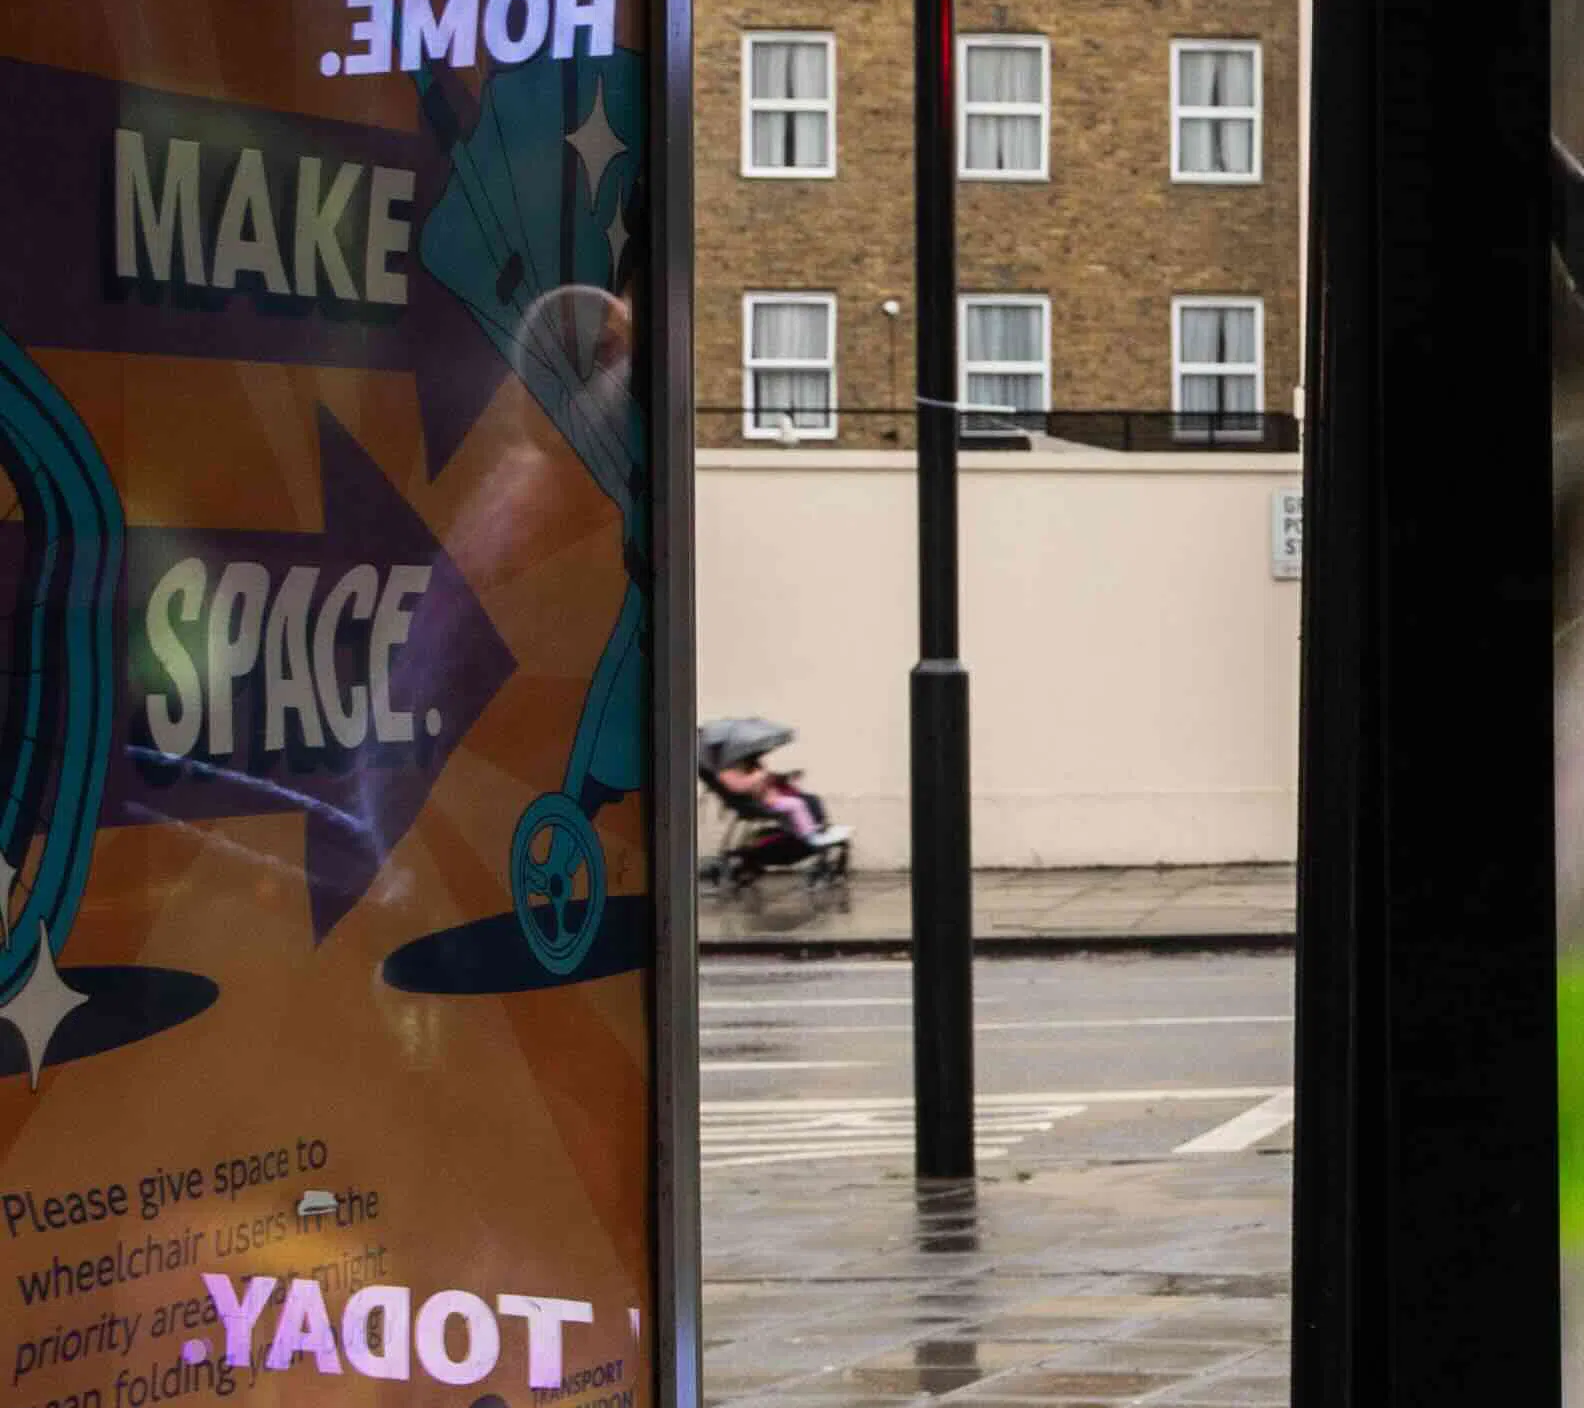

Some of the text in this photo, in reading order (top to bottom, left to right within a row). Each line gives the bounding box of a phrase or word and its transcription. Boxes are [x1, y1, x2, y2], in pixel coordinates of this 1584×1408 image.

[114, 128, 416, 306] MAKE
[145, 556, 442, 757] SPACE.
[2, 1135, 329, 1238] Please give space to
[17, 1228, 206, 1306] wheelchair
[214, 1209, 289, 1258] users
[335, 1187, 380, 1228] the
[11, 1311, 143, 1387] priority
